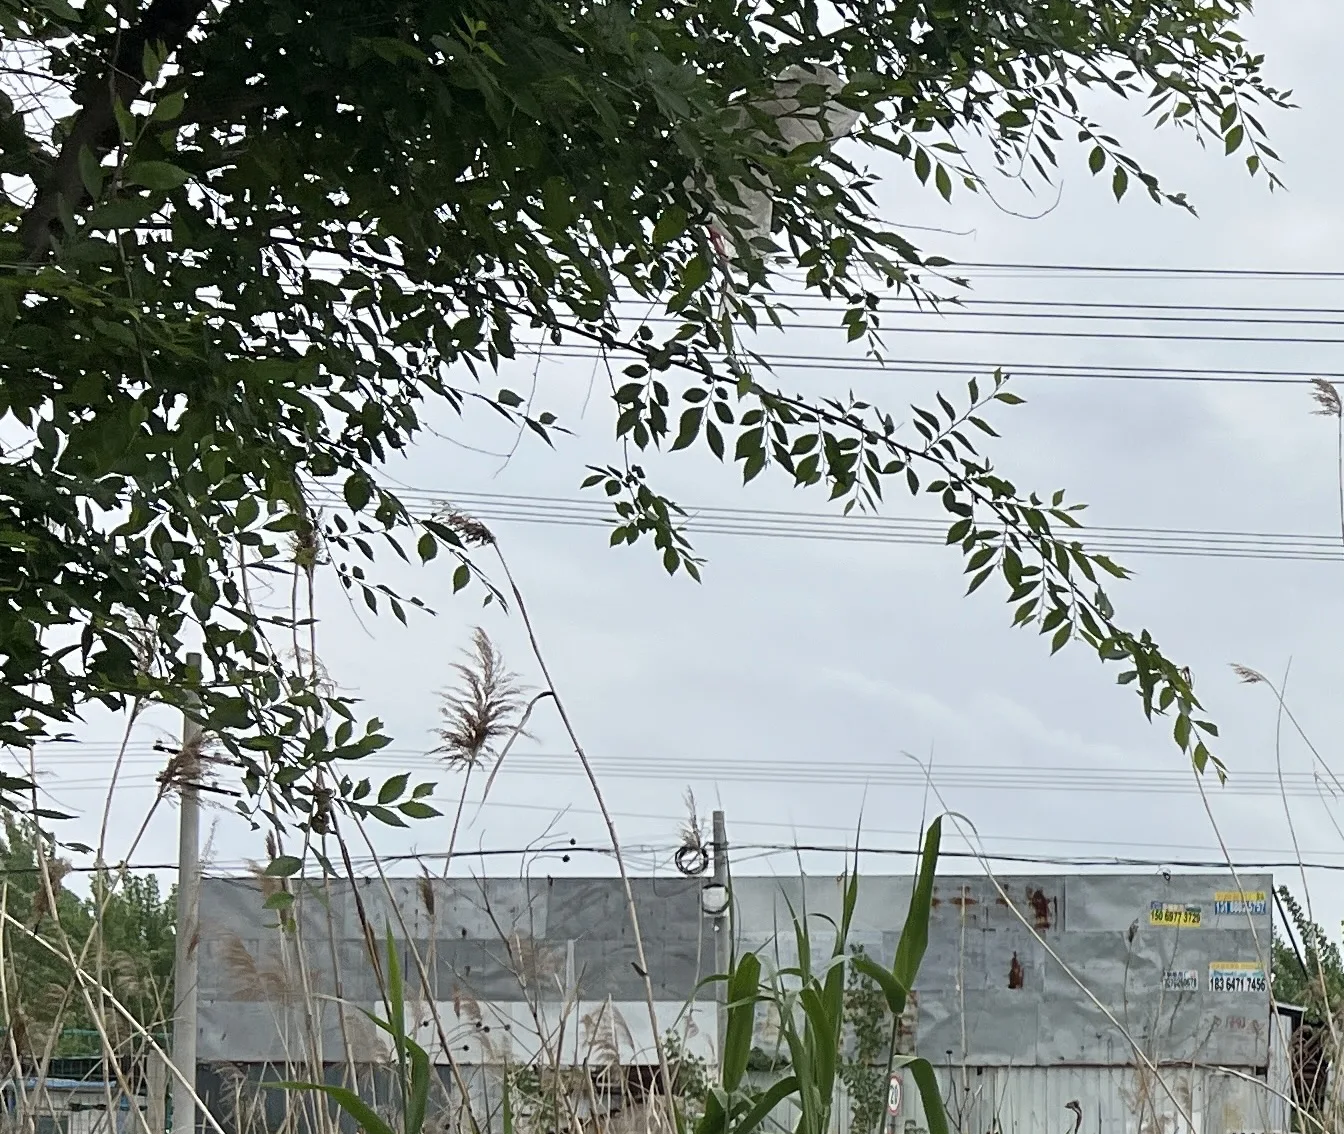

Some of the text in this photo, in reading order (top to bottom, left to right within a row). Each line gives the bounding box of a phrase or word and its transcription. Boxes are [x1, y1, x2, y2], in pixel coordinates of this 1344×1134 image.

[1210, 977, 1224, 991] 183
[1226, 977, 1244, 991] 6471
[1246, 977, 1266, 991] 7456
